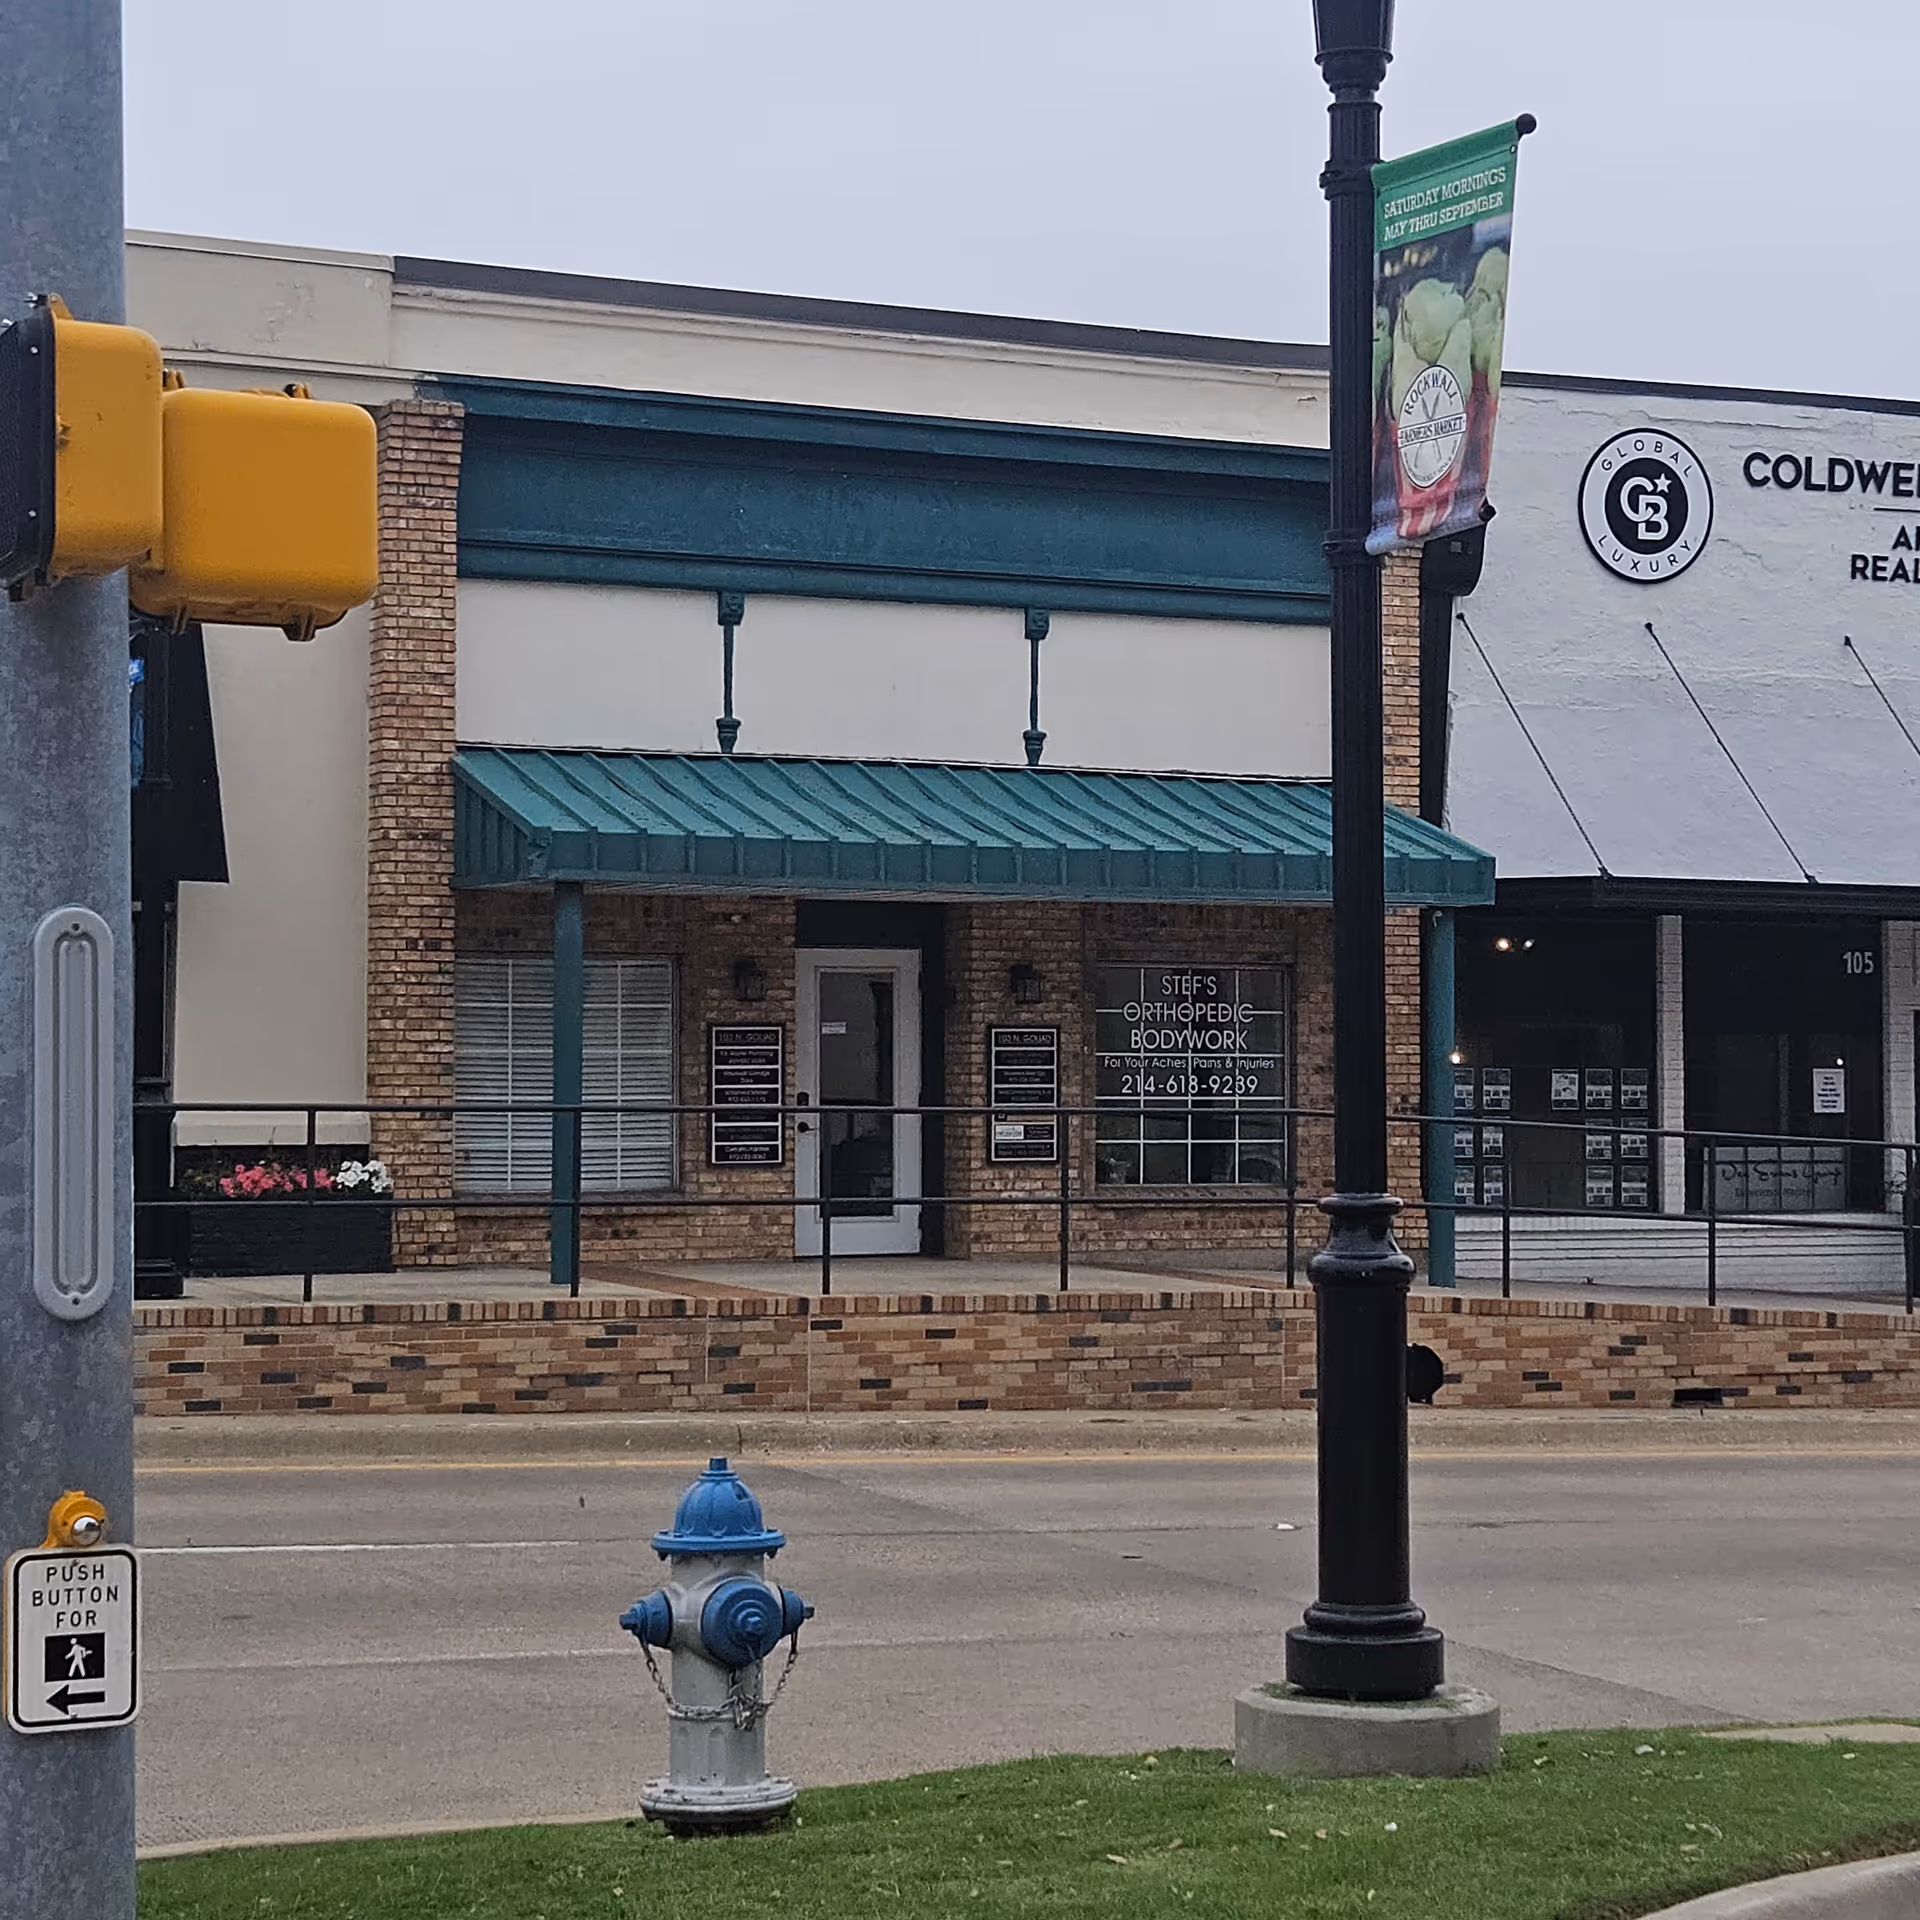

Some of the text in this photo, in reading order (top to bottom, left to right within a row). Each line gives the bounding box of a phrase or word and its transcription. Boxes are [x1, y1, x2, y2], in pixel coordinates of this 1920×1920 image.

[1384, 166, 1506, 219] SATURDAY MORNINGS
[1384, 191, 1504, 242] MAY THRU SEPTEMBER
[1404, 369, 1458, 415] ROCKWALL
[1601, 439, 1692, 478] GLOBAL
[1743, 452, 1920, 498] COLDWE
[1598, 534, 1691, 572] LUXURY
[1842, 951, 1874, 974] 105
[1161, 975, 1217, 996] STEF'S
[1123, 1002, 1254, 1023] ORTHOPEDIC
[1130, 1029, 1248, 1050] BODYWORK
[1104, 1056, 1121, 1069] For
[1124, 1056, 1149, 1069] Your
[1193, 1057, 1222, 1069] Pains
[1225, 1057, 1233, 1069] &
[1236, 1057, 1275, 1070] Injuries
[1121, 1074, 1258, 1095] 214-618-9239
[46, 1564, 105, 1583] PUSH
[32, 1586, 118, 1607] BUTTON
[56, 1610, 97, 1628] FOR
